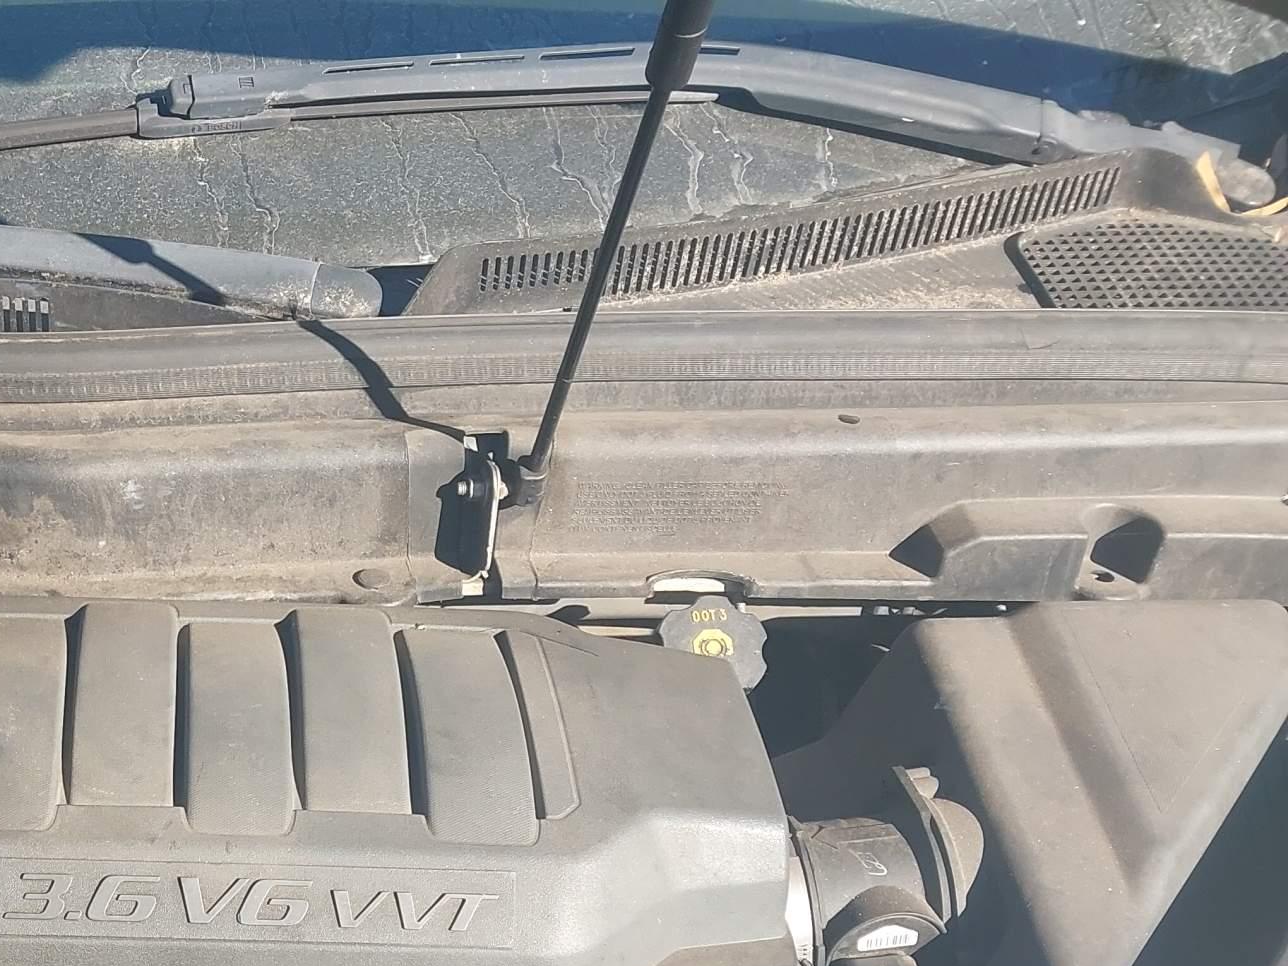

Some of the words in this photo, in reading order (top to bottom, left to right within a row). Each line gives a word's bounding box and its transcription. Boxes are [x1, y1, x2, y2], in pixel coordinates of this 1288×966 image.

[720, 609, 727, 620] 3
[3, 873, 162, 923] 3.6
[179, 877, 312, 926] V6
[331, 889, 500, 932] VVT
